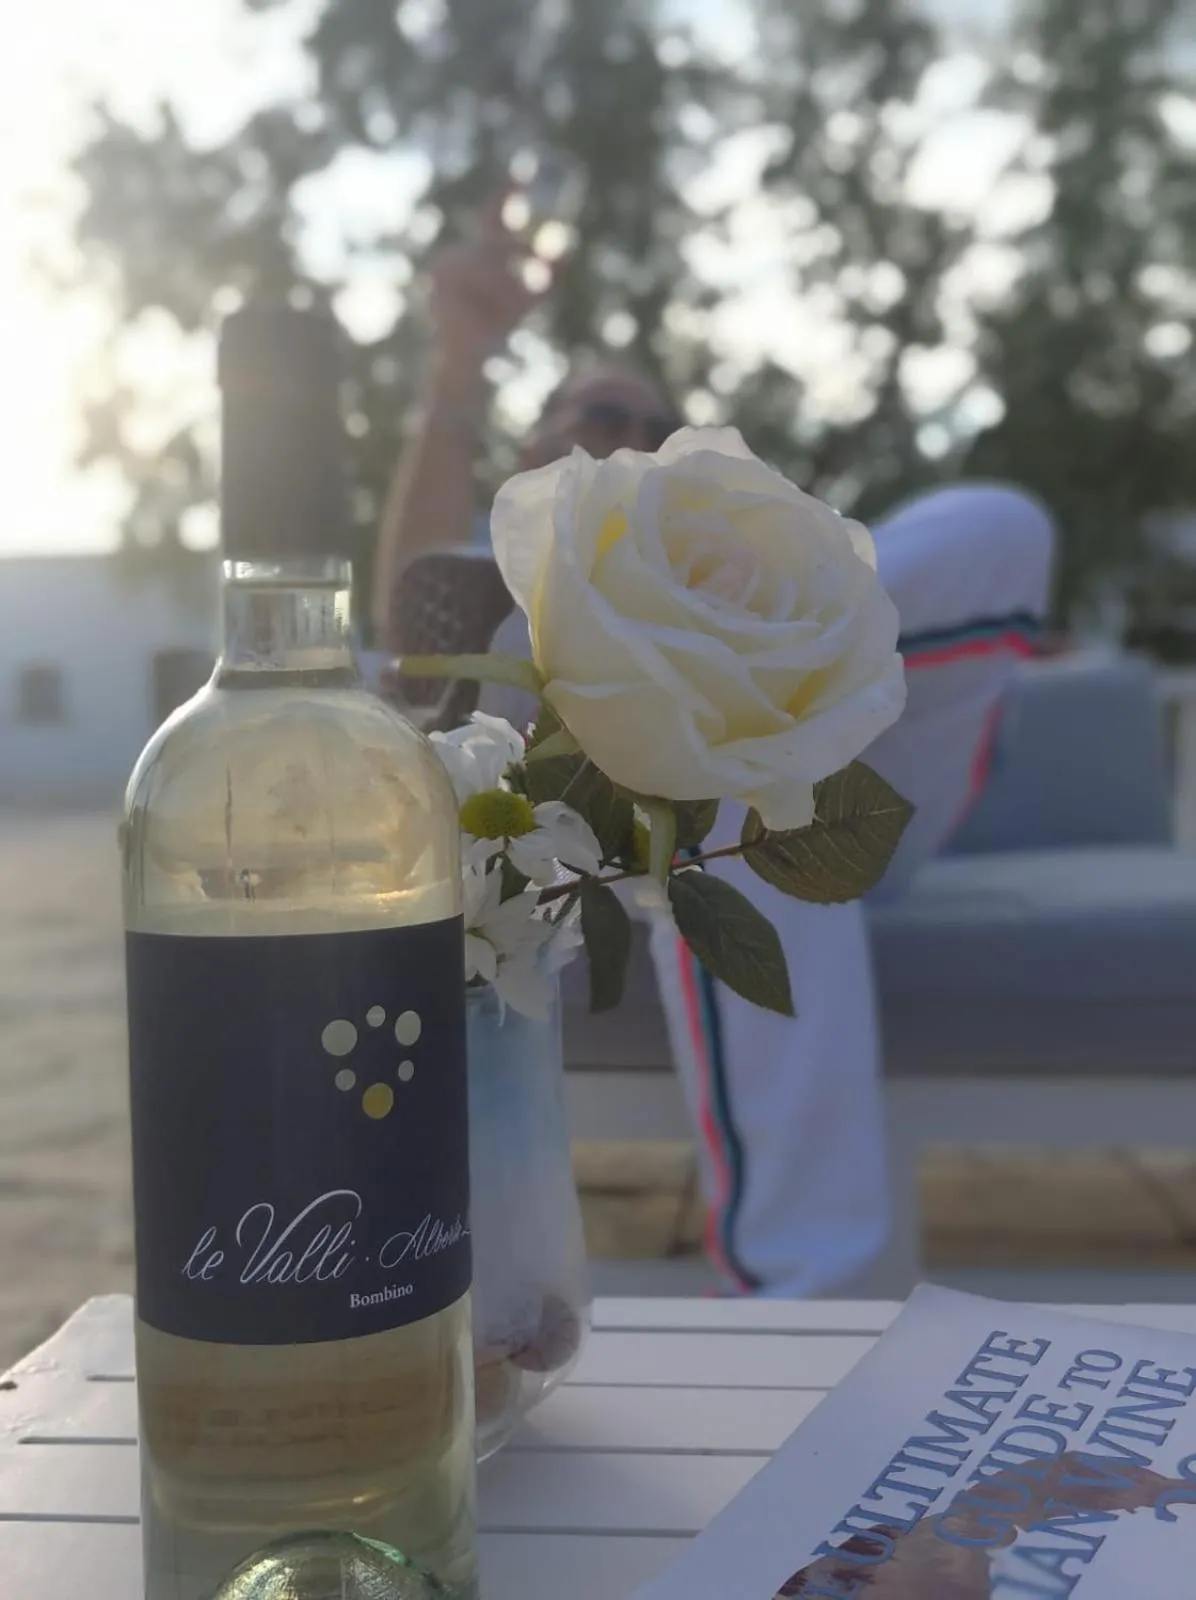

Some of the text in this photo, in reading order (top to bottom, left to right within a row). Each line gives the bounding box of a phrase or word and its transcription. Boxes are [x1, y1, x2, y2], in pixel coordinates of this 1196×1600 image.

[235, 1188, 362, 1284] Valli
[349, 1282, 415, 1308] Bombino
[811, 1330, 1052, 1565] ULTIMATE
[931, 1348, 1123, 1548] GUIDE TO
[1058, 1359, 1196, 1489] WINE
